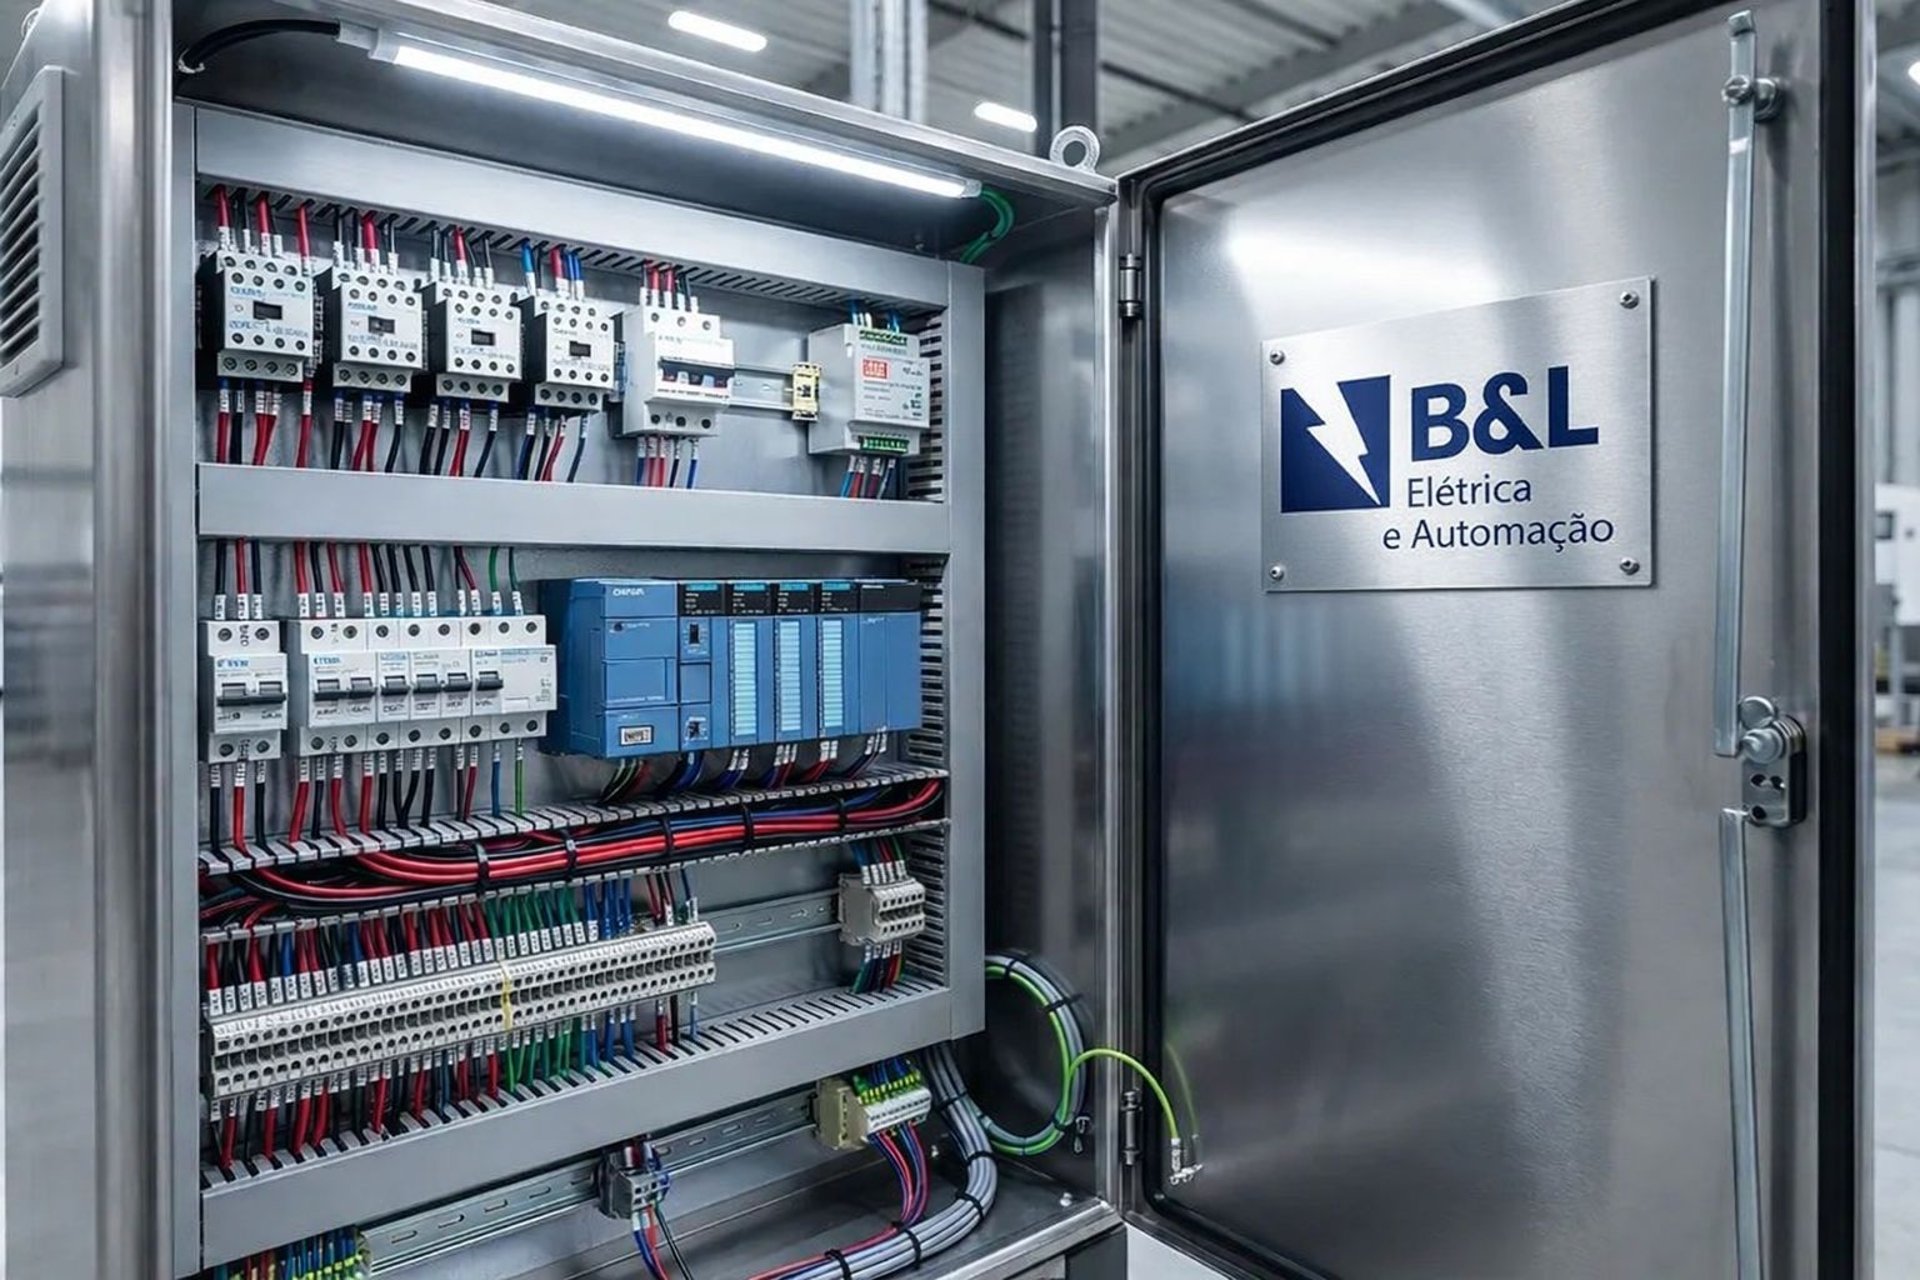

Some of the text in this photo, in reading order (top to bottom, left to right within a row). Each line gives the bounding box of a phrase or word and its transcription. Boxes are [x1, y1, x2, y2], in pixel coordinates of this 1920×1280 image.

[1411, 366, 1598, 461] B&L
[1408, 474, 1531, 507] Elétrica
[1383, 513, 1614, 553] e Automação
